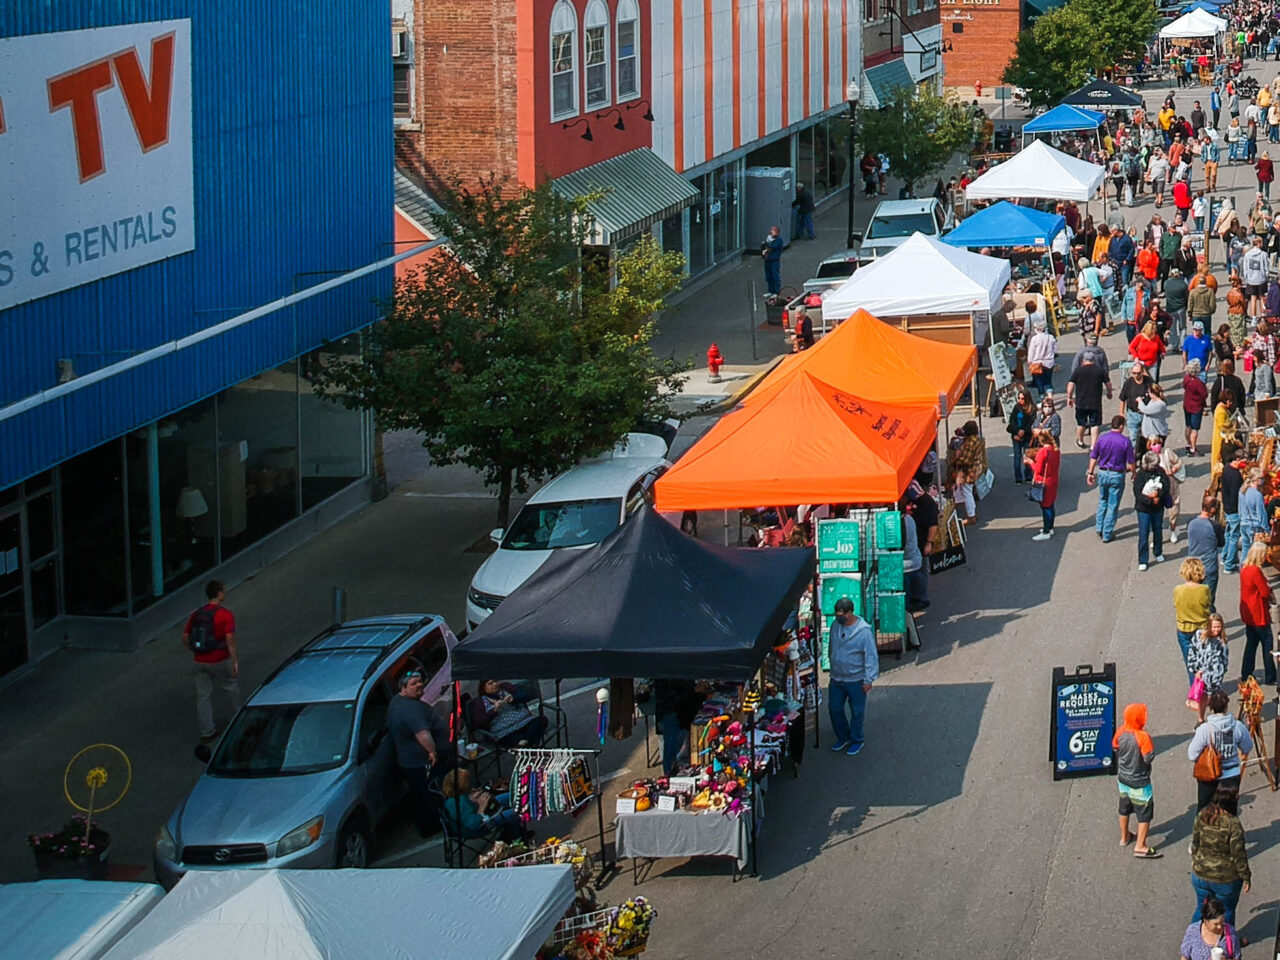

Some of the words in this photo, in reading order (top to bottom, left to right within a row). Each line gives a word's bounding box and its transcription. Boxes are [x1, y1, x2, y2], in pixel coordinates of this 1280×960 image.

[46, 29, 177, 185] TV
[30, 241, 50, 277] &
[65, 205, 177, 268] RENTALS
[933, 553, 963, 570] welcome
[1060, 697, 1109, 708] REQUESTED
[1070, 692, 1098, 700] MASKS
[1069, 731, 1083, 753] 6
[1083, 742, 1096, 752] FT
[1081, 730, 1100, 738] STAY
